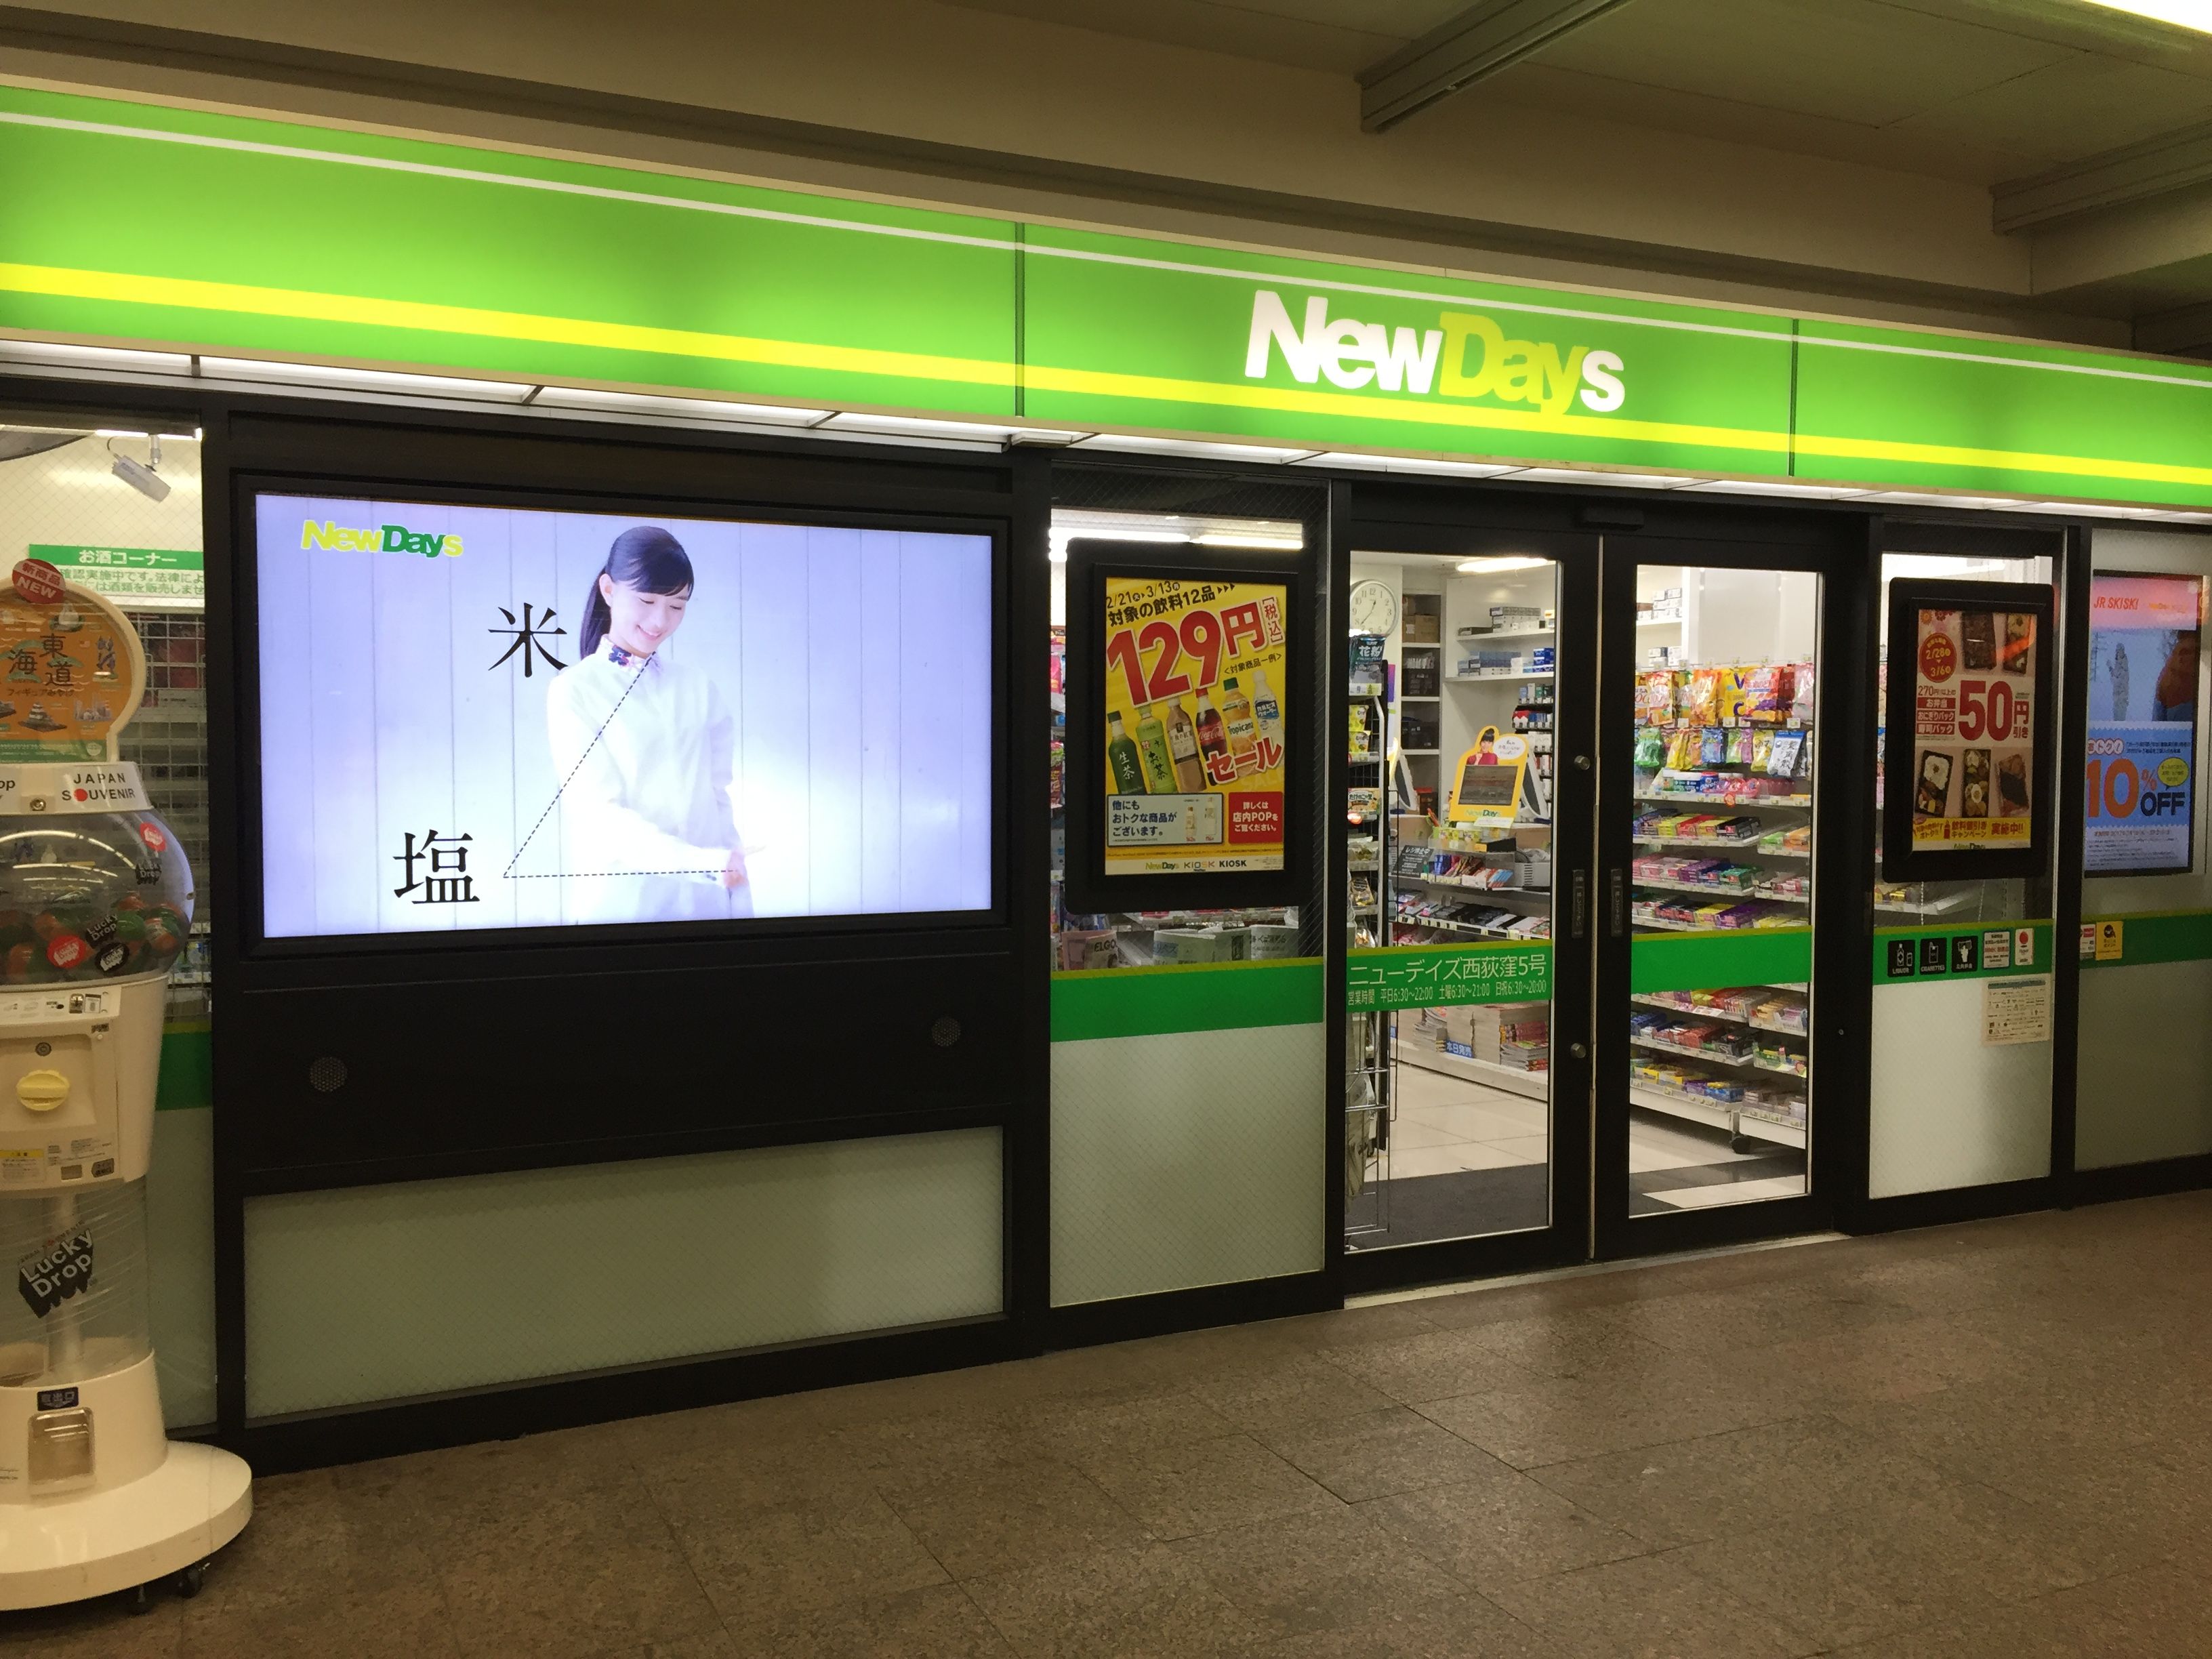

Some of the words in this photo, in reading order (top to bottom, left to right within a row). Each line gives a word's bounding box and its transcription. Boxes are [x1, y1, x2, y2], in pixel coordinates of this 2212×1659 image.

[1245, 289, 1625, 415] NewDays
[301, 520, 464, 558] NewDays
[79, 550, 178, 565] お酒コーナー
[22, 561, 61, 586] 新商品
[17, 575, 57, 599] NEW
[1108, 583, 1216, 628] 対象の飲料12品
[2093, 596, 2106, 609] JR
[2108, 596, 2139, 611] SKISKI
[488, 602, 568, 678] 米
[1106, 600, 1266, 706] 129円
[1358, 646, 1383, 657] 花粉
[1917, 711, 1954, 721] おにぎりパック
[1958, 680, 2013, 741] 50
[2014, 701, 2029, 725] 円
[2013, 726, 2029, 739] 引き
[1119, 751, 1135, 781] 生茶
[1206, 737, 1284, 784] セール
[73, 773, 126, 784] JAPAN
[1112, 800, 1140, 811] 他にも
[1243, 801, 1269, 811] 詳しくは
[2140, 792, 2186, 817] OFF
[1112, 811, 1177, 823] おトクな商品が
[1233, 811, 1278, 823] 店内POPを
[1234, 823, 1277, 833] ご覧ください。
[1112, 825, 1164, 837] ございます。
[392, 828, 480, 905] 塩
[1219, 859, 1248, 868] KIOSK
[86, 914, 118, 935] Lucky
[91, 923, 117, 941] Drop
[1349, 954, 1547, 985] ニューデイズ西荻窪5号
[1348, 988, 1375, 1006] 営業時間
[21, 1229, 93, 1283] Lucky
[31, 1254, 91, 1298] Drop
